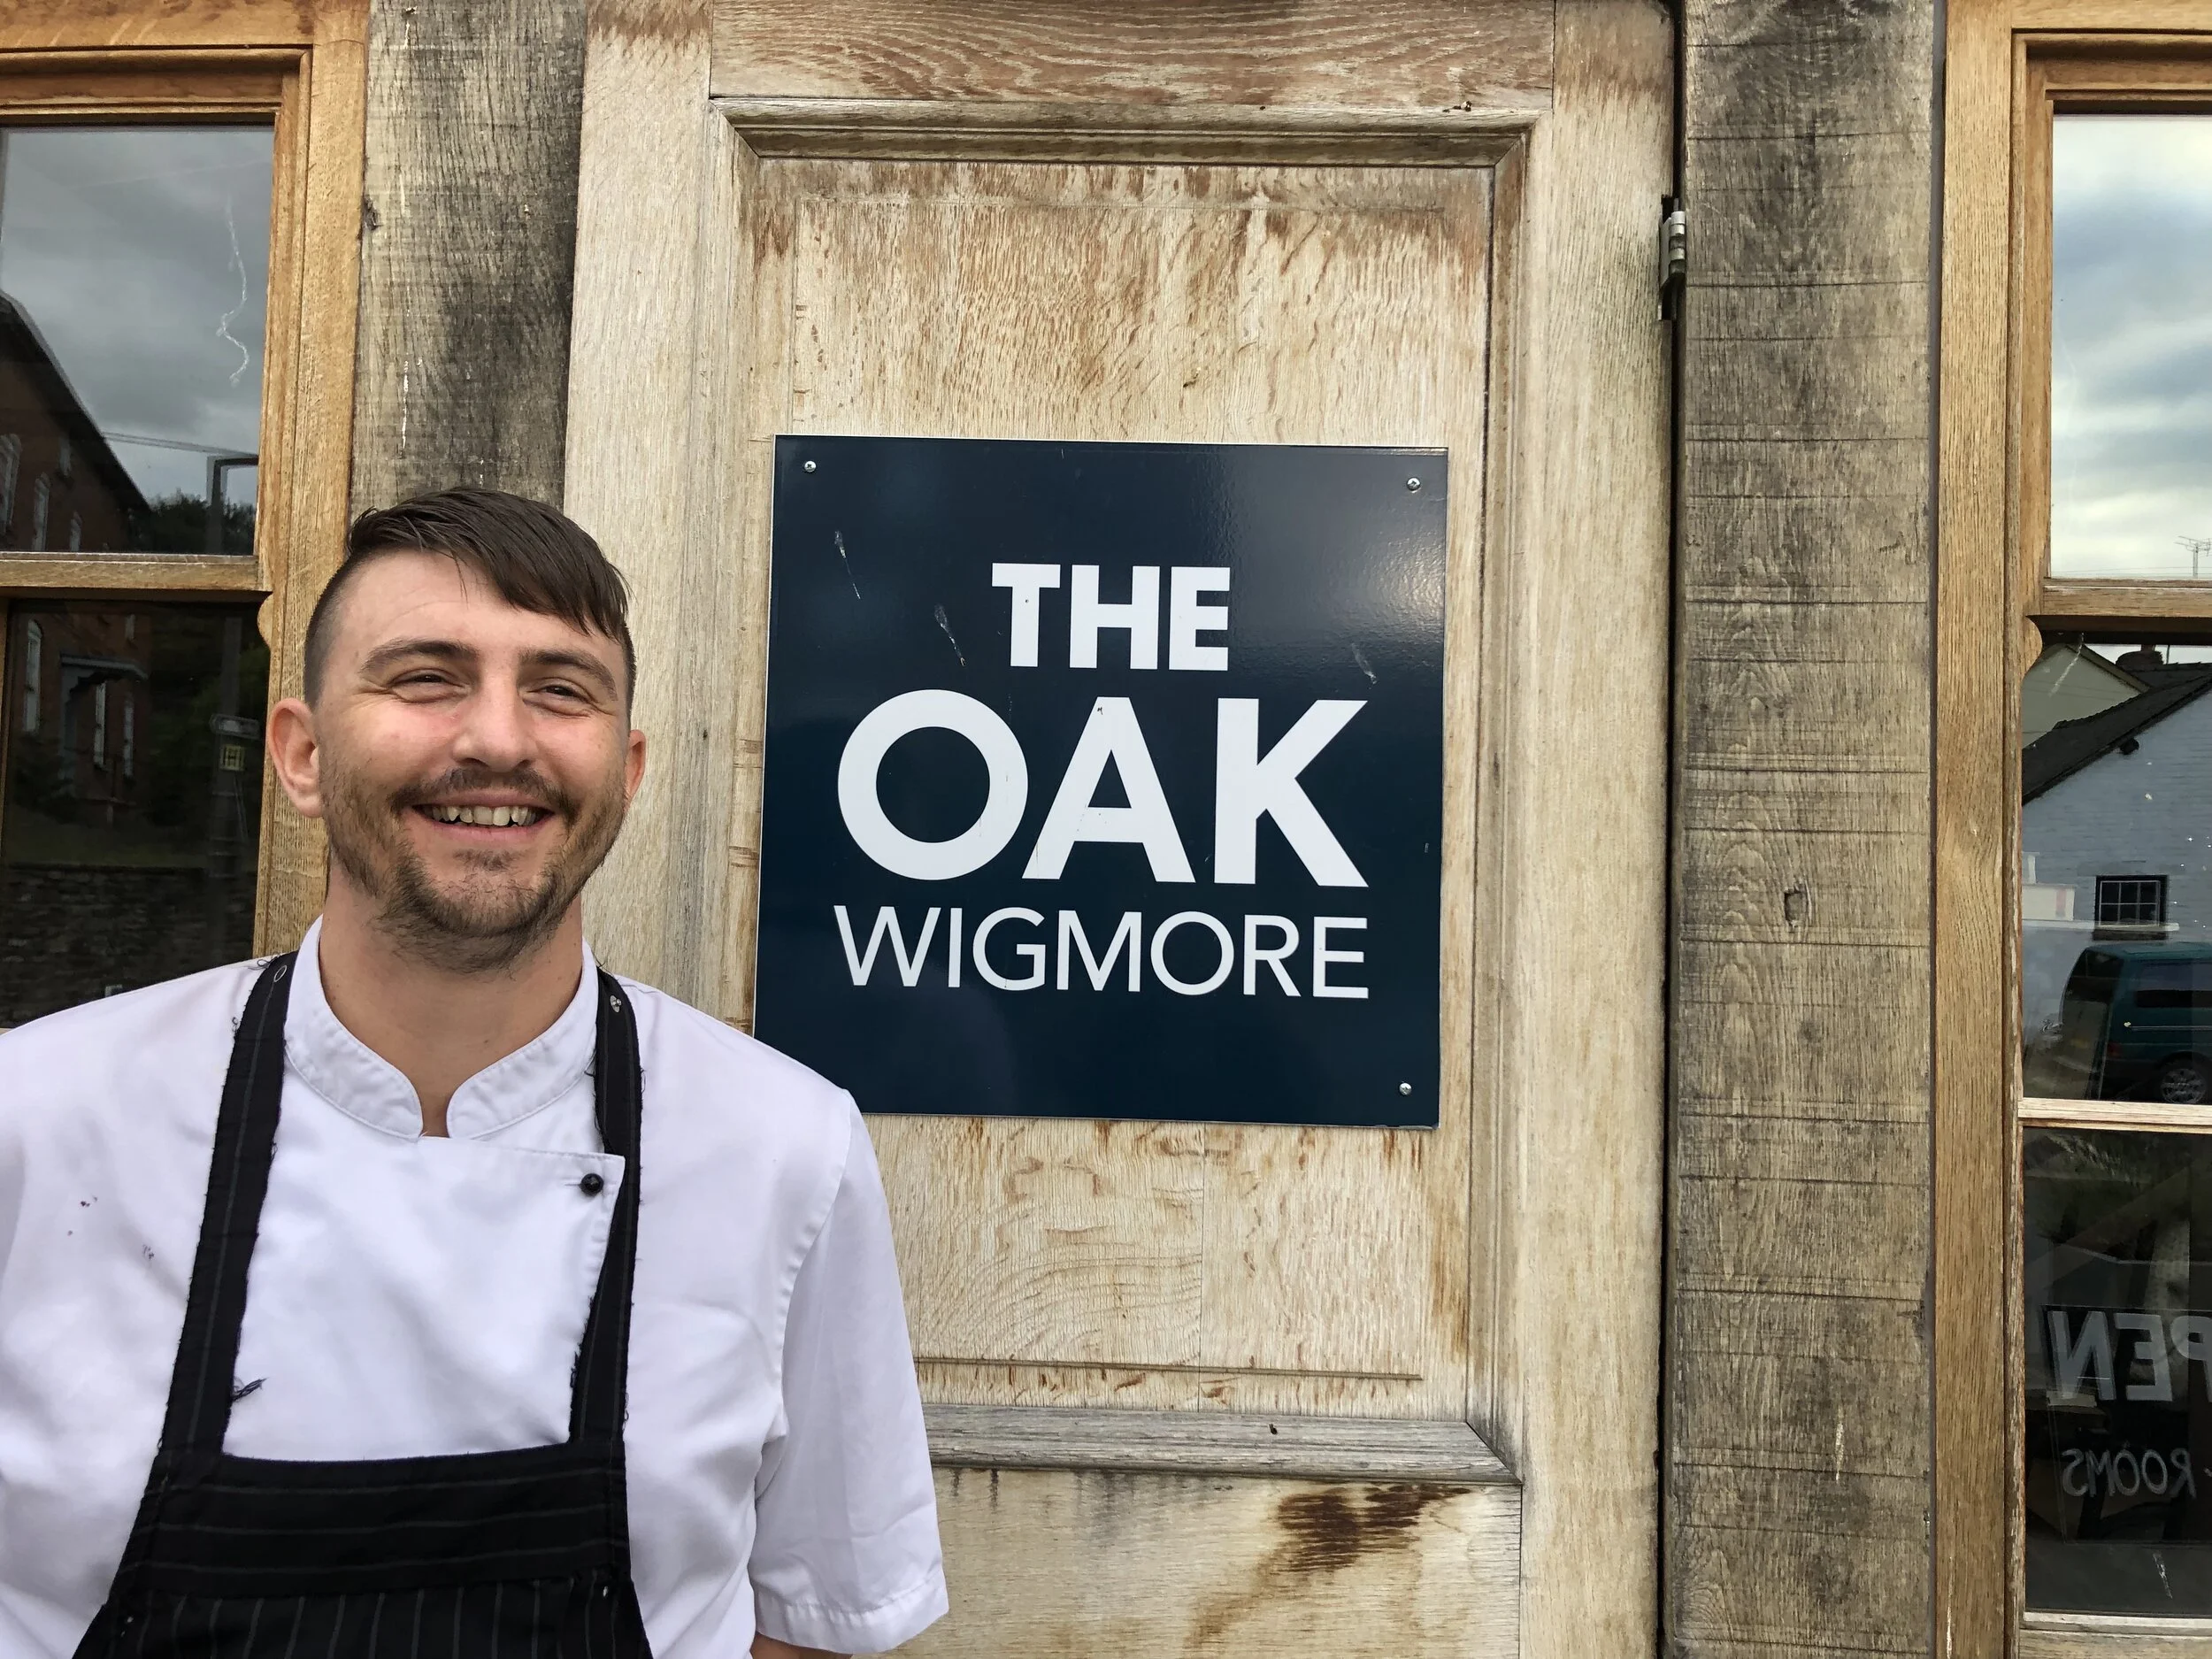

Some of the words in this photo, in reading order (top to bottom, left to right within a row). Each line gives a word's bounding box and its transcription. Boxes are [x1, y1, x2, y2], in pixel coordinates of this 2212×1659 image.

[992, 563, 1231, 672] THE
[837, 689, 1369, 887] OAK
[833, 905, 1369, 999] WIGMORE
